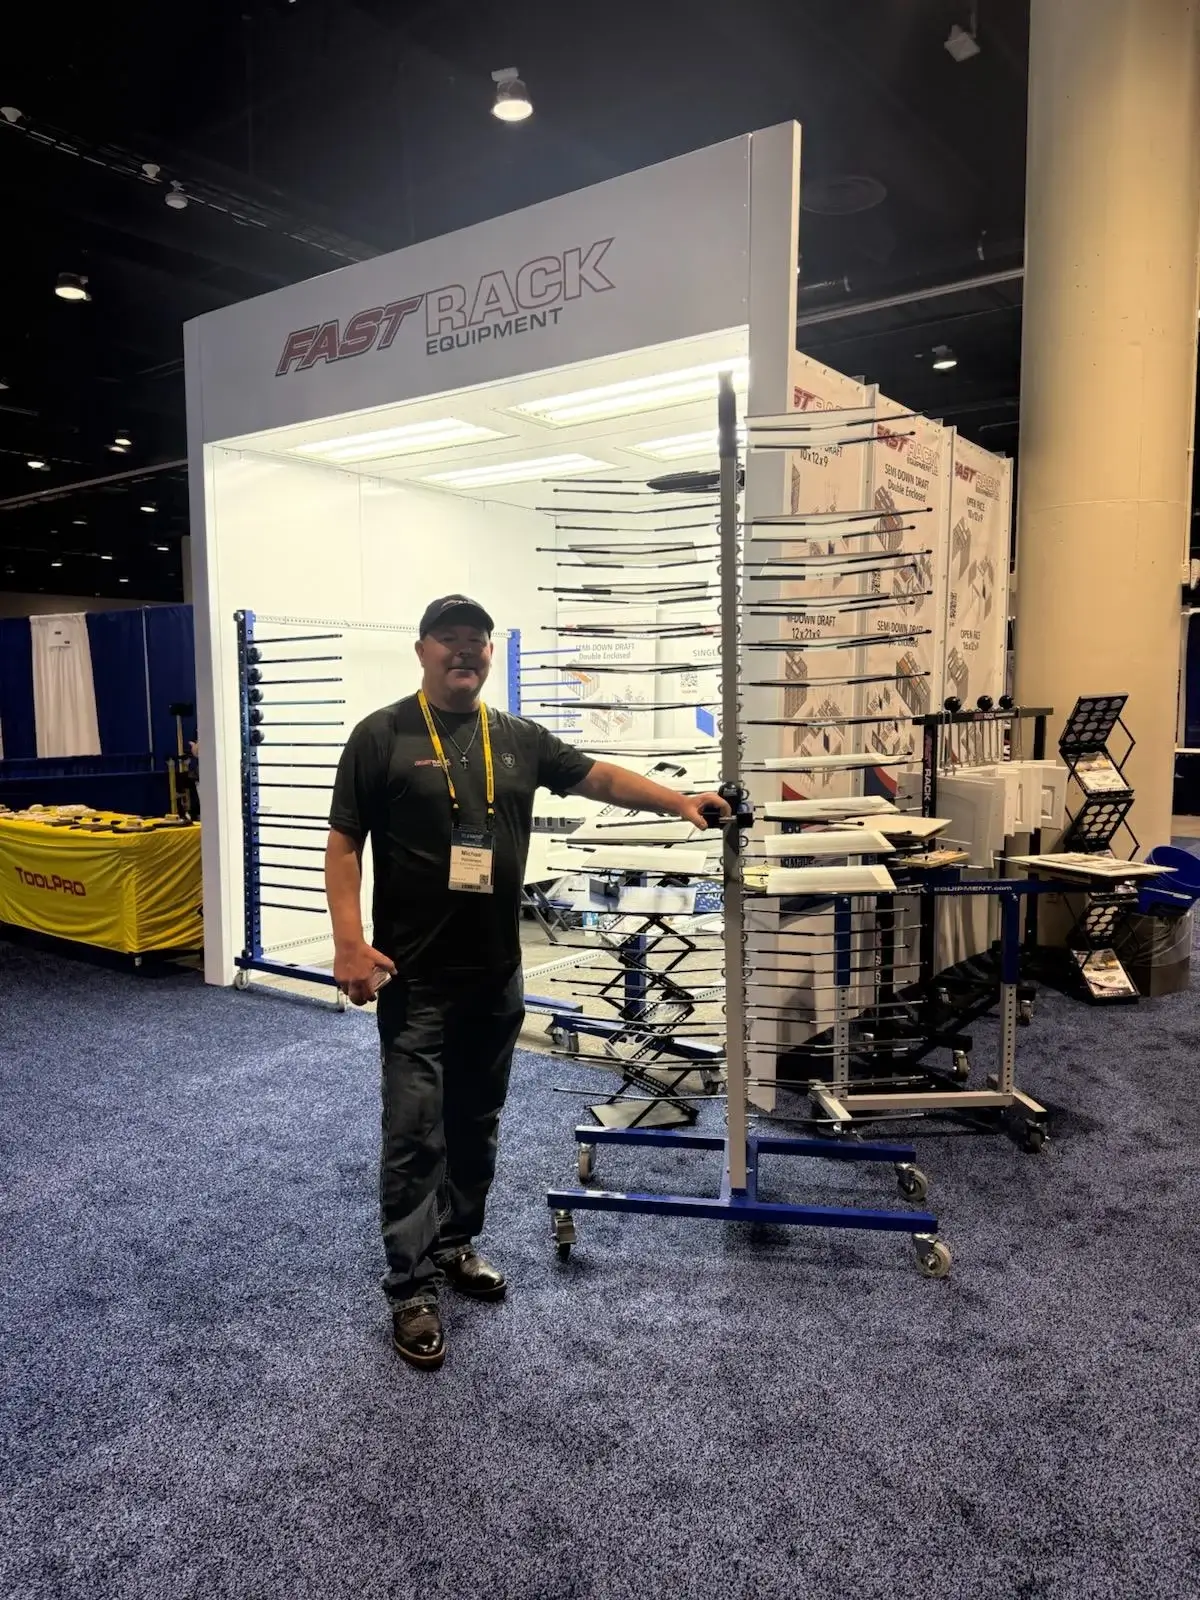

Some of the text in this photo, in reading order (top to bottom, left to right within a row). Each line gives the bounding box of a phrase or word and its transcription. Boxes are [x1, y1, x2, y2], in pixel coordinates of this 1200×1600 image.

[426, 307, 563, 356] EQUIPMENT
[817, 614, 836, 627] DRAFT
[593, 643, 613, 652] DOWN
[615, 642, 635, 651] DRAFT
[579, 651, 631, 661] Double Enclosed
